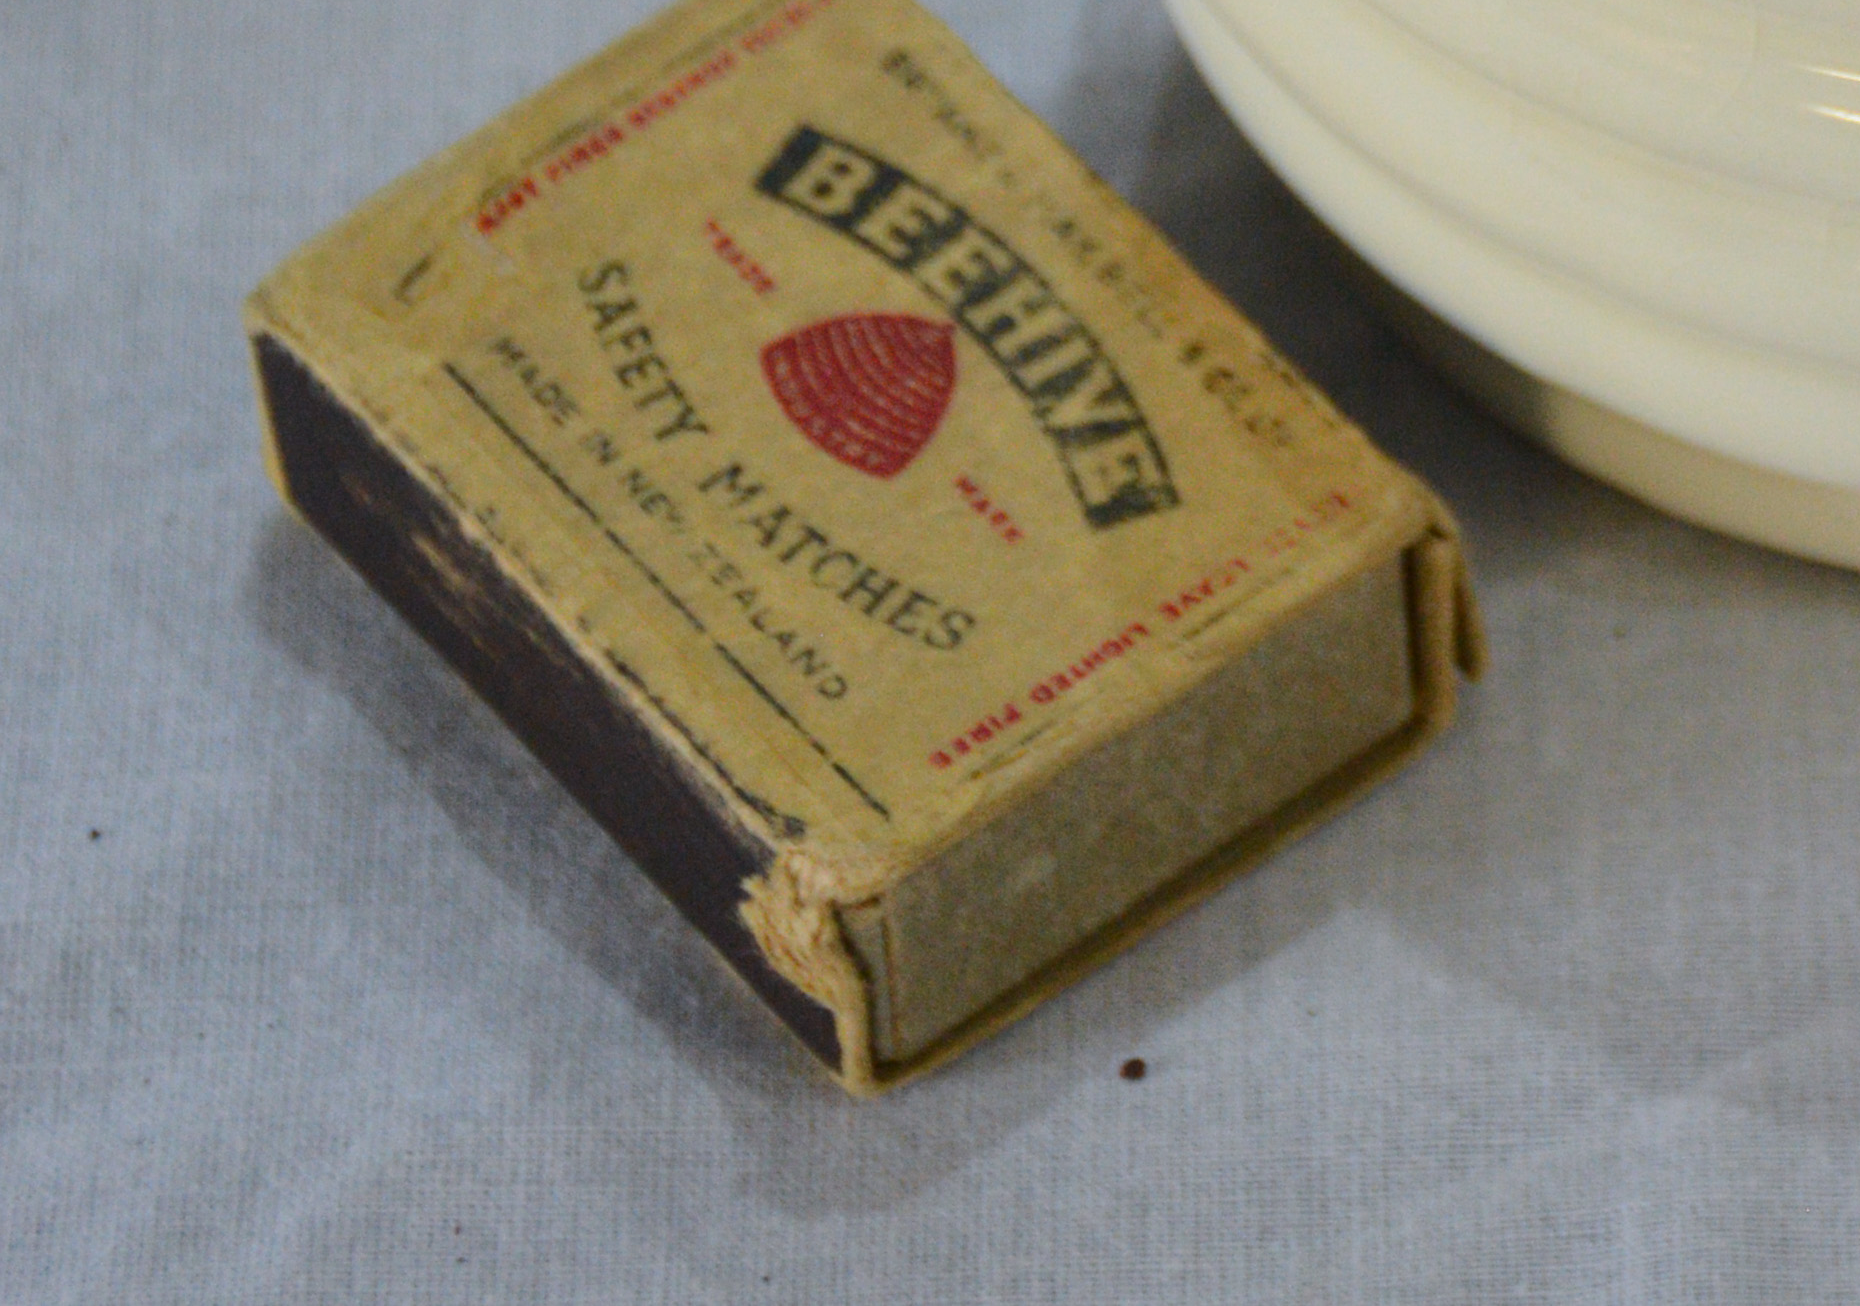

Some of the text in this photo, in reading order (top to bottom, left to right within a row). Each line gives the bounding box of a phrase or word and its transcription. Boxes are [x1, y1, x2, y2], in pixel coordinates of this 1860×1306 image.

[704, 216, 776, 294] TRADE
[783, 139, 1160, 511] BEEHIVE
[492, 335, 579, 427] MADE
[583, 430, 619, 467] IN
[690, 541, 849, 701] ZEALAND
[579, 259, 976, 651] SAFETY MATCHES
[954, 473, 1024, 546] MARK
[1028, 622, 1150, 705] LIGHTED
